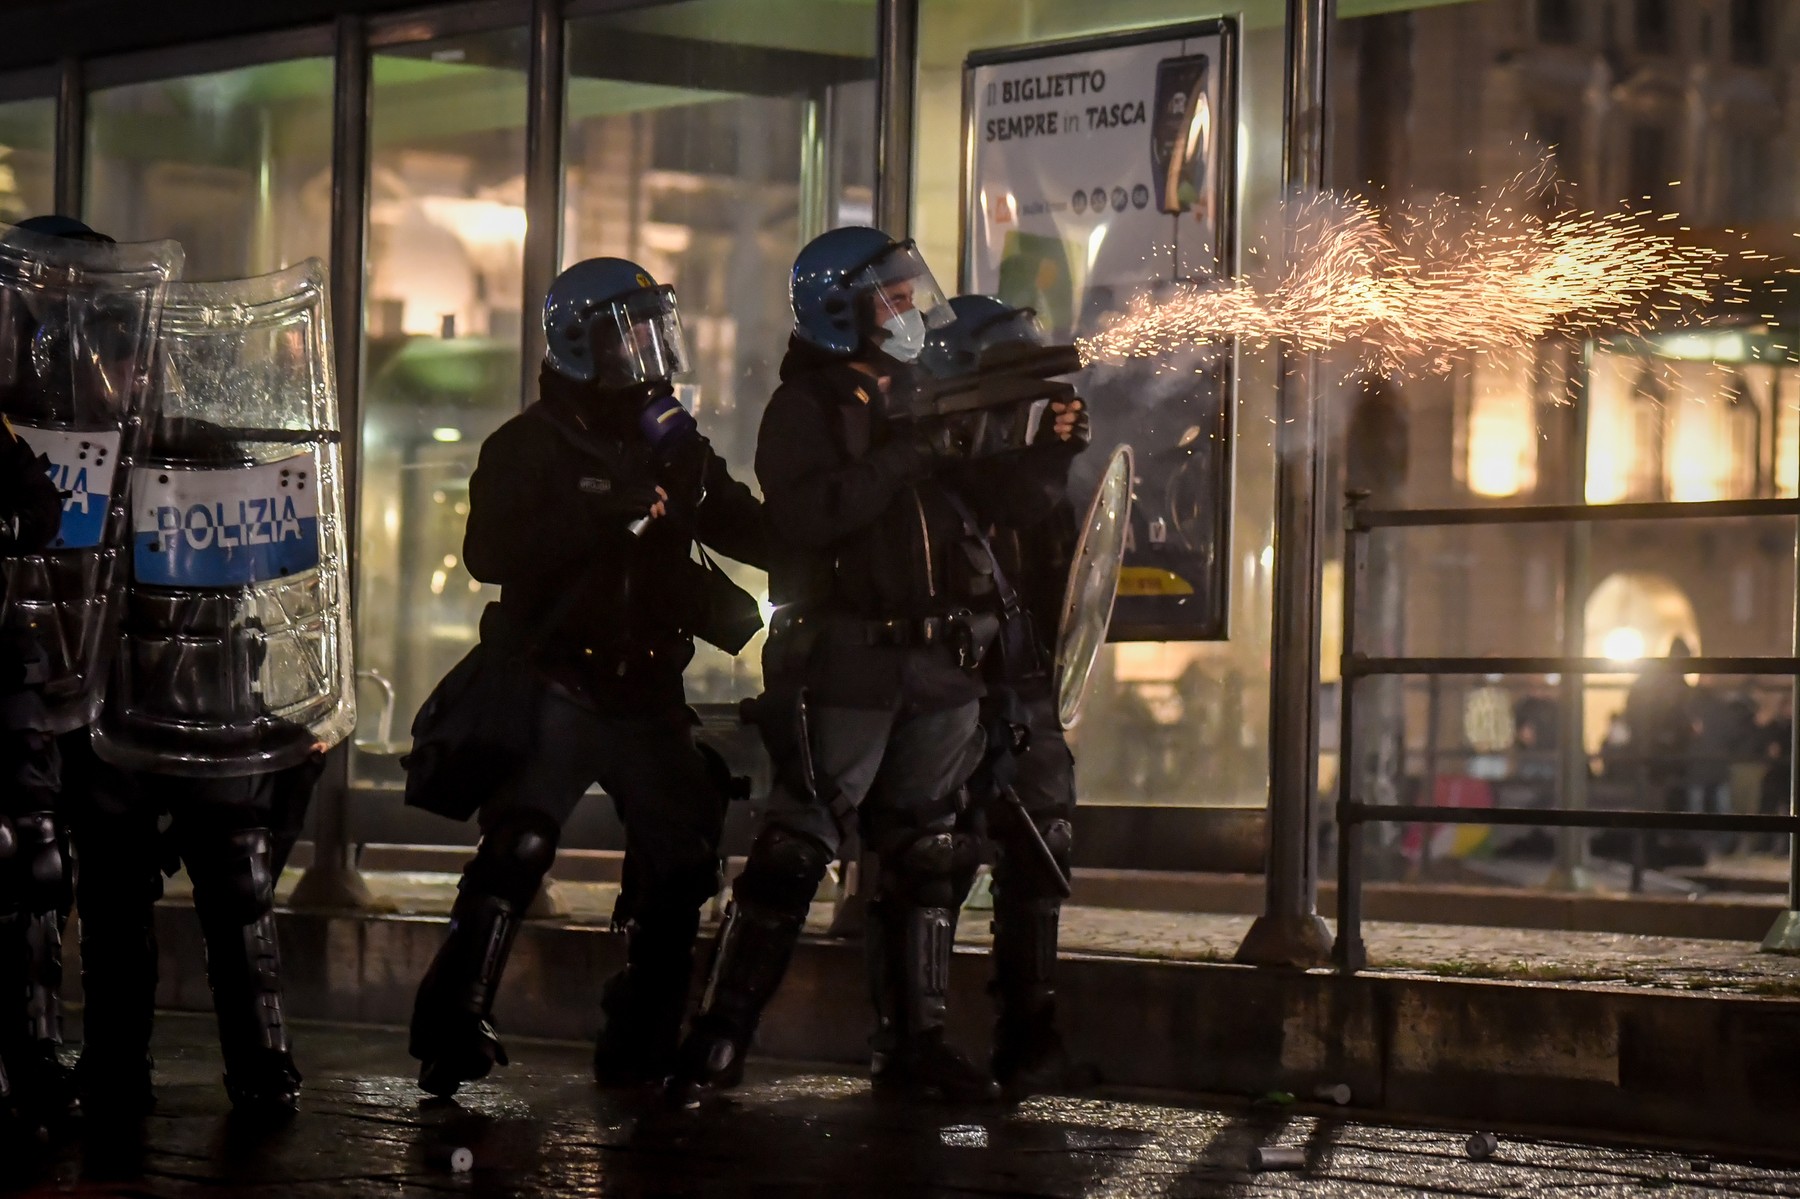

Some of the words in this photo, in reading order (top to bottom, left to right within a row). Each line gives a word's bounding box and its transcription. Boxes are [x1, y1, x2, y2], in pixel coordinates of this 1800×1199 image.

[1003, 70, 1105, 103] BIGLIETTO
[986, 112, 1058, 142] SEMPRE
[1064, 114, 1079, 133] in
[1086, 101, 1146, 130] TASCA
[157, 496, 302, 552] POLIZIA
